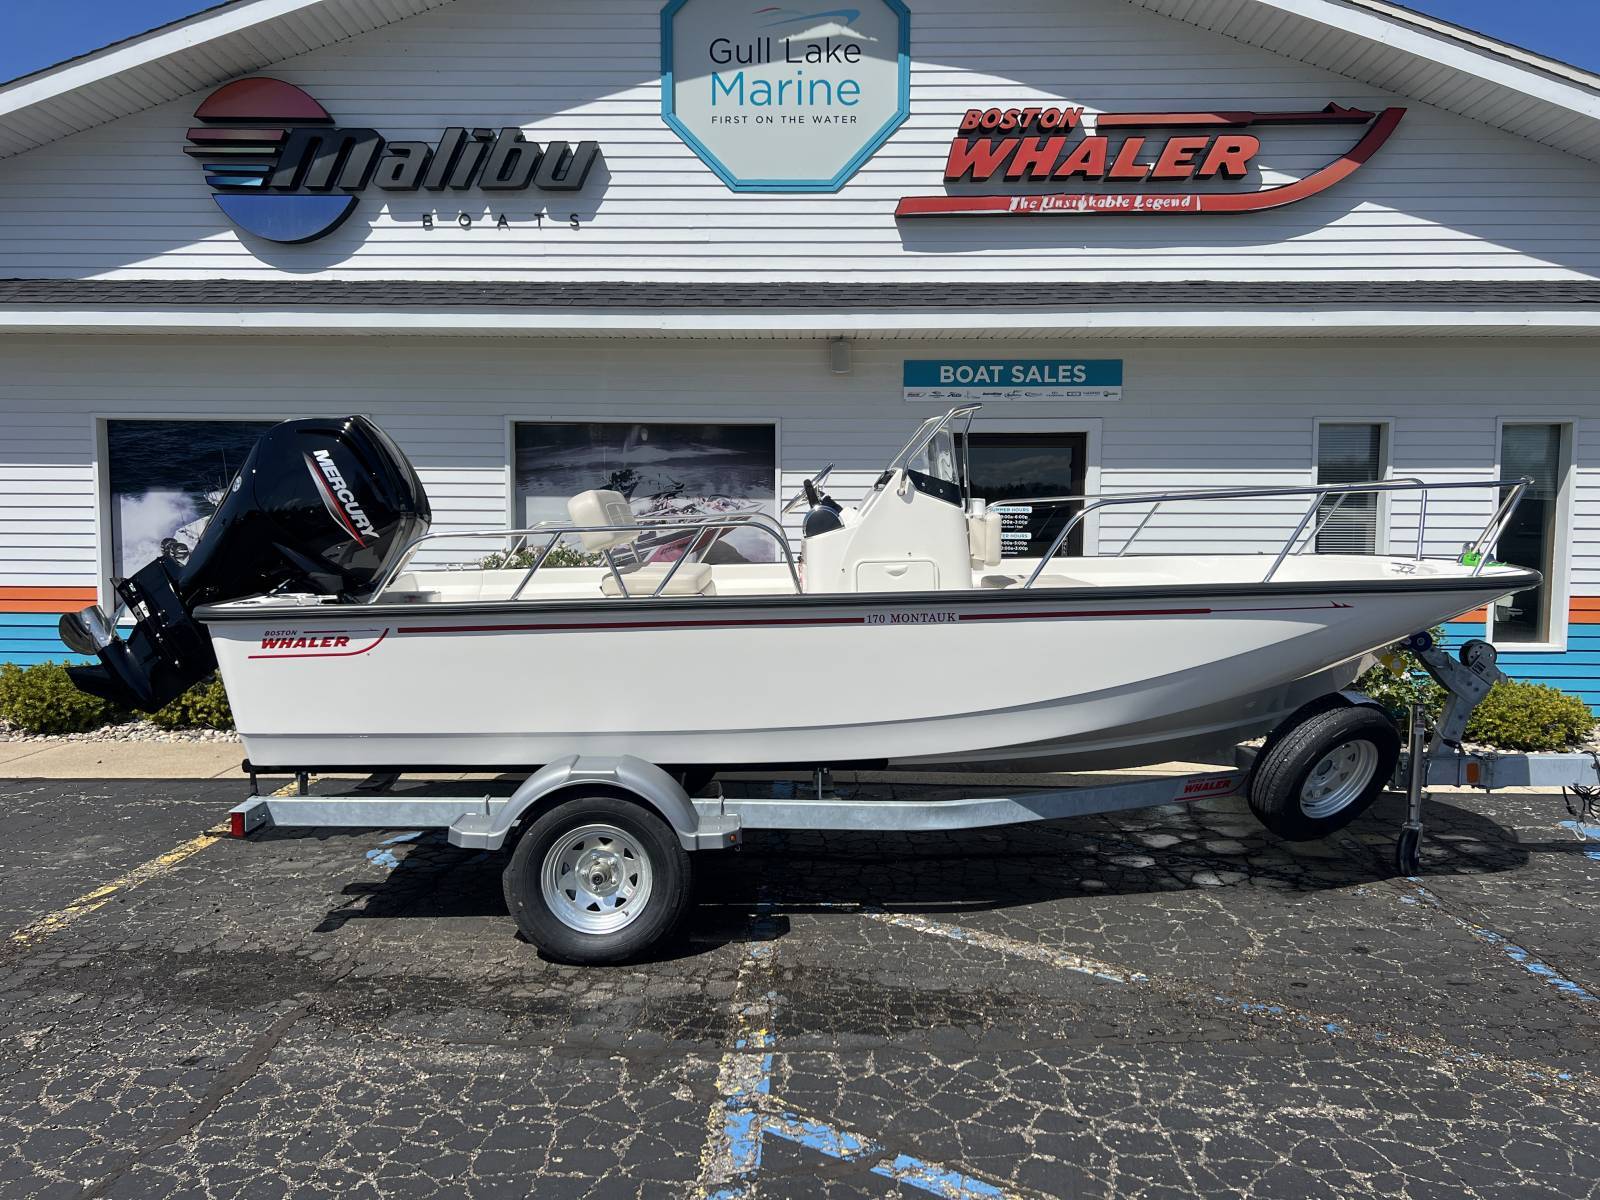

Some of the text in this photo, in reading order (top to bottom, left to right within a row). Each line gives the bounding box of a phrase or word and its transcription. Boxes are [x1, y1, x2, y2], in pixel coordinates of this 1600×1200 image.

[709, 36, 862, 64] Gull Lake
[711, 70, 861, 106] Marine
[711, 115, 857, 124] FIRST ON THE WATER
[958, 107, 1084, 133] BOSTON
[268, 127, 600, 191] Malibu
[944, 135, 1261, 181] WHALER
[1008, 195, 1036, 211] The
[1133, 195, 1191, 211] Legend
[422, 213, 581, 229] BOATS
[940, 365, 1087, 383] BOAT SALES
[313, 449, 380, 538] MERCURY
[867, 612, 957, 624] 170 MONTAUK
[264, 629, 298, 637] BOSTON
[261, 636, 350, 650] WHALER
